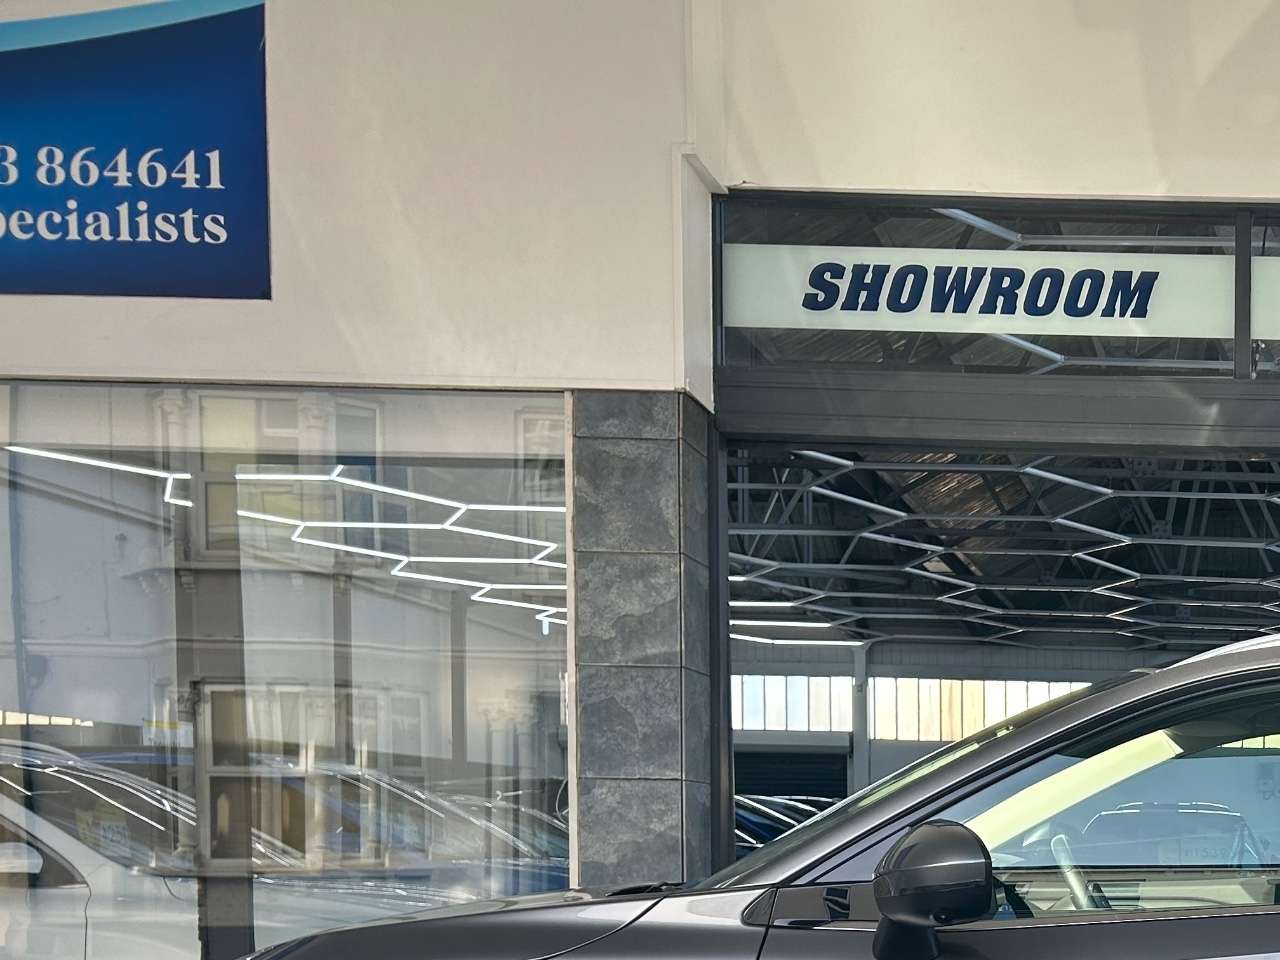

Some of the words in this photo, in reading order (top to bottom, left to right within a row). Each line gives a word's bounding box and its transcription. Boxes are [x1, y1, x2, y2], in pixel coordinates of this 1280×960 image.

[36, 146, 225, 189] 864641
[0, 199, 228, 244] ecialists
[801, 263, 1160, 319] SHOWROOM
